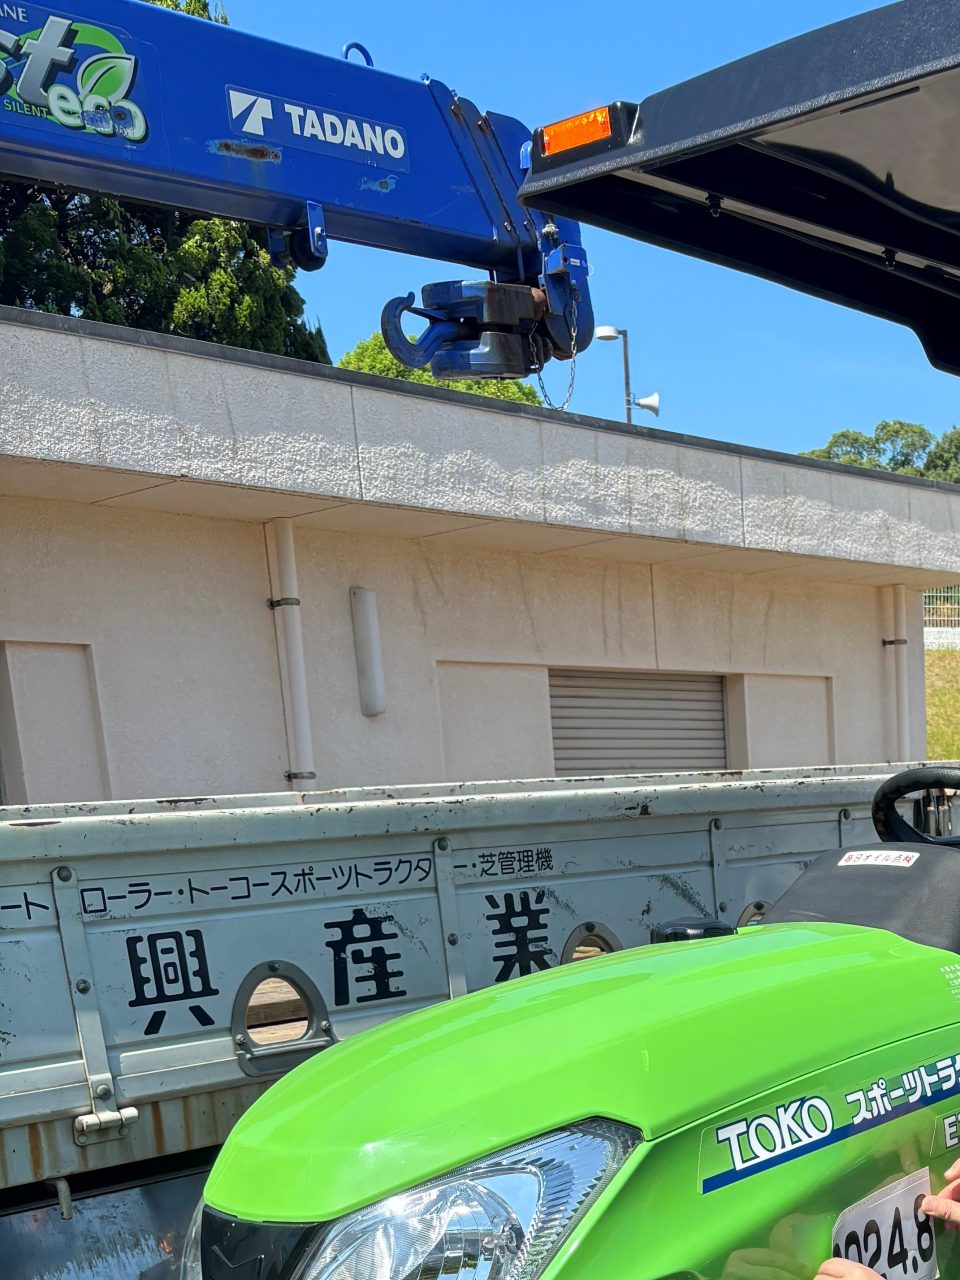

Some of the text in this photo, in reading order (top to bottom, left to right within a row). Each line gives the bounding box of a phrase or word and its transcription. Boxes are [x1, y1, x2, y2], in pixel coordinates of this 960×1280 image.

[4, 99, 49, 120] SILENT
[284, 103, 405, 160] TADANO
[716, 1096, 833, 1171] TOKO
[833, 1193, 934, 1279] 024.8
